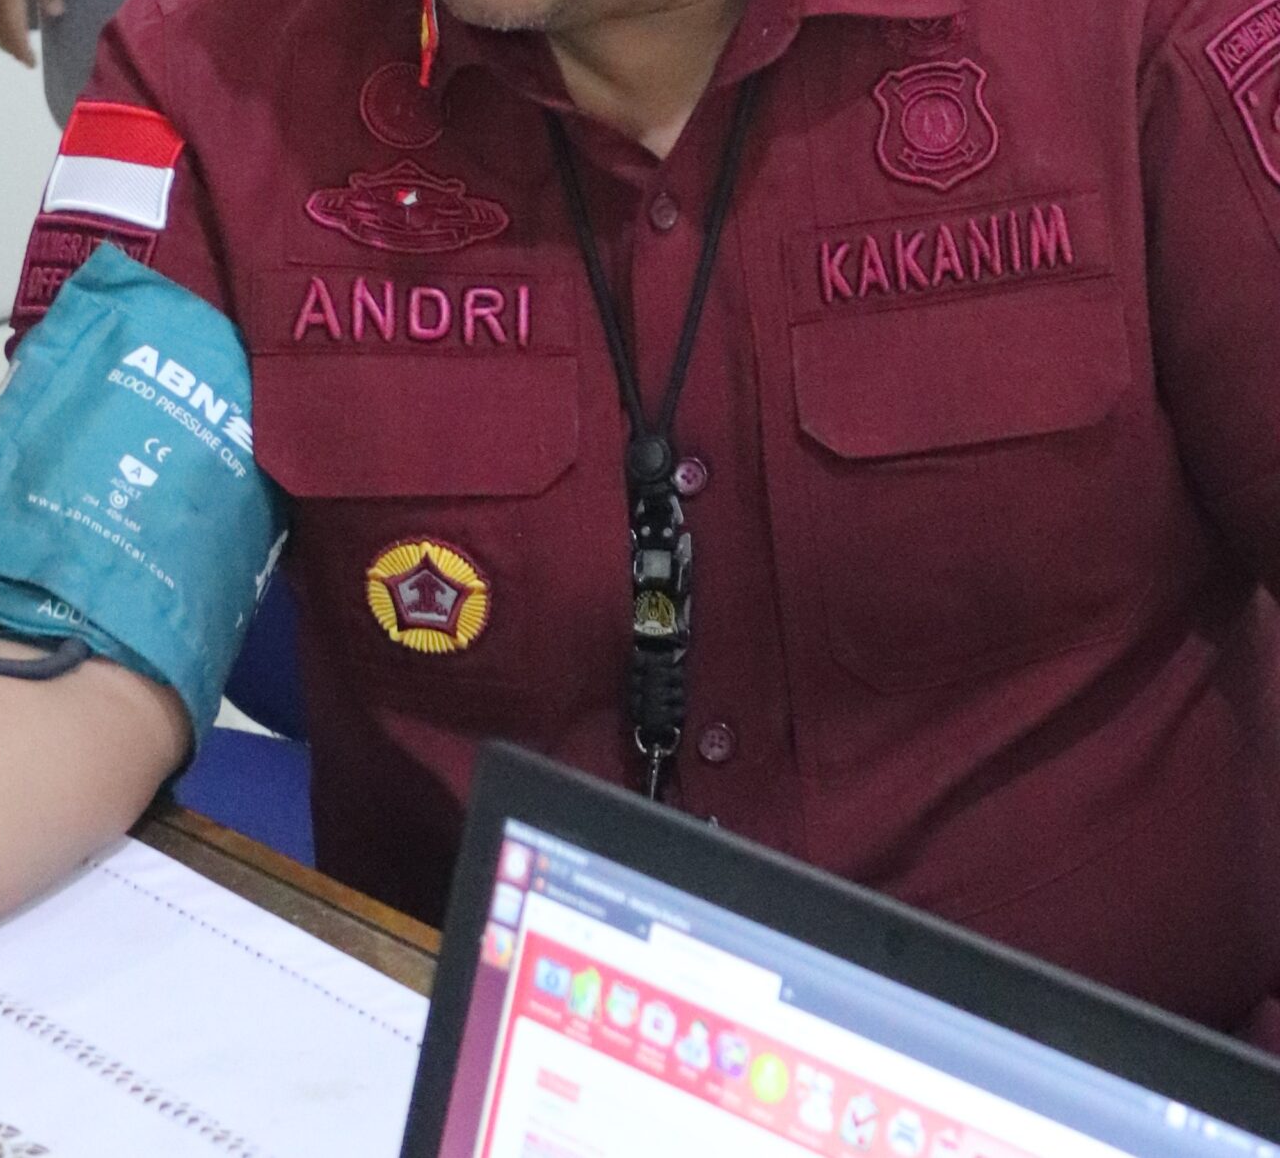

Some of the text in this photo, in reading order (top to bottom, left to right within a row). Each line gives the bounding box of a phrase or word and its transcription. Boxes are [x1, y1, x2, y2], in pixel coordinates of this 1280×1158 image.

[820, 203, 1074, 303] KAKANIM
[292, 276, 532, 346] ANDRI
[107, 369, 247, 478] BLOOD PRESSURE CUFF
[122, 344, 229, 425] ABN
[130, 466, 143, 480] A
[144, 437, 173, 463] CE
[27, 492, 176, 590] www.abnmedical.com
